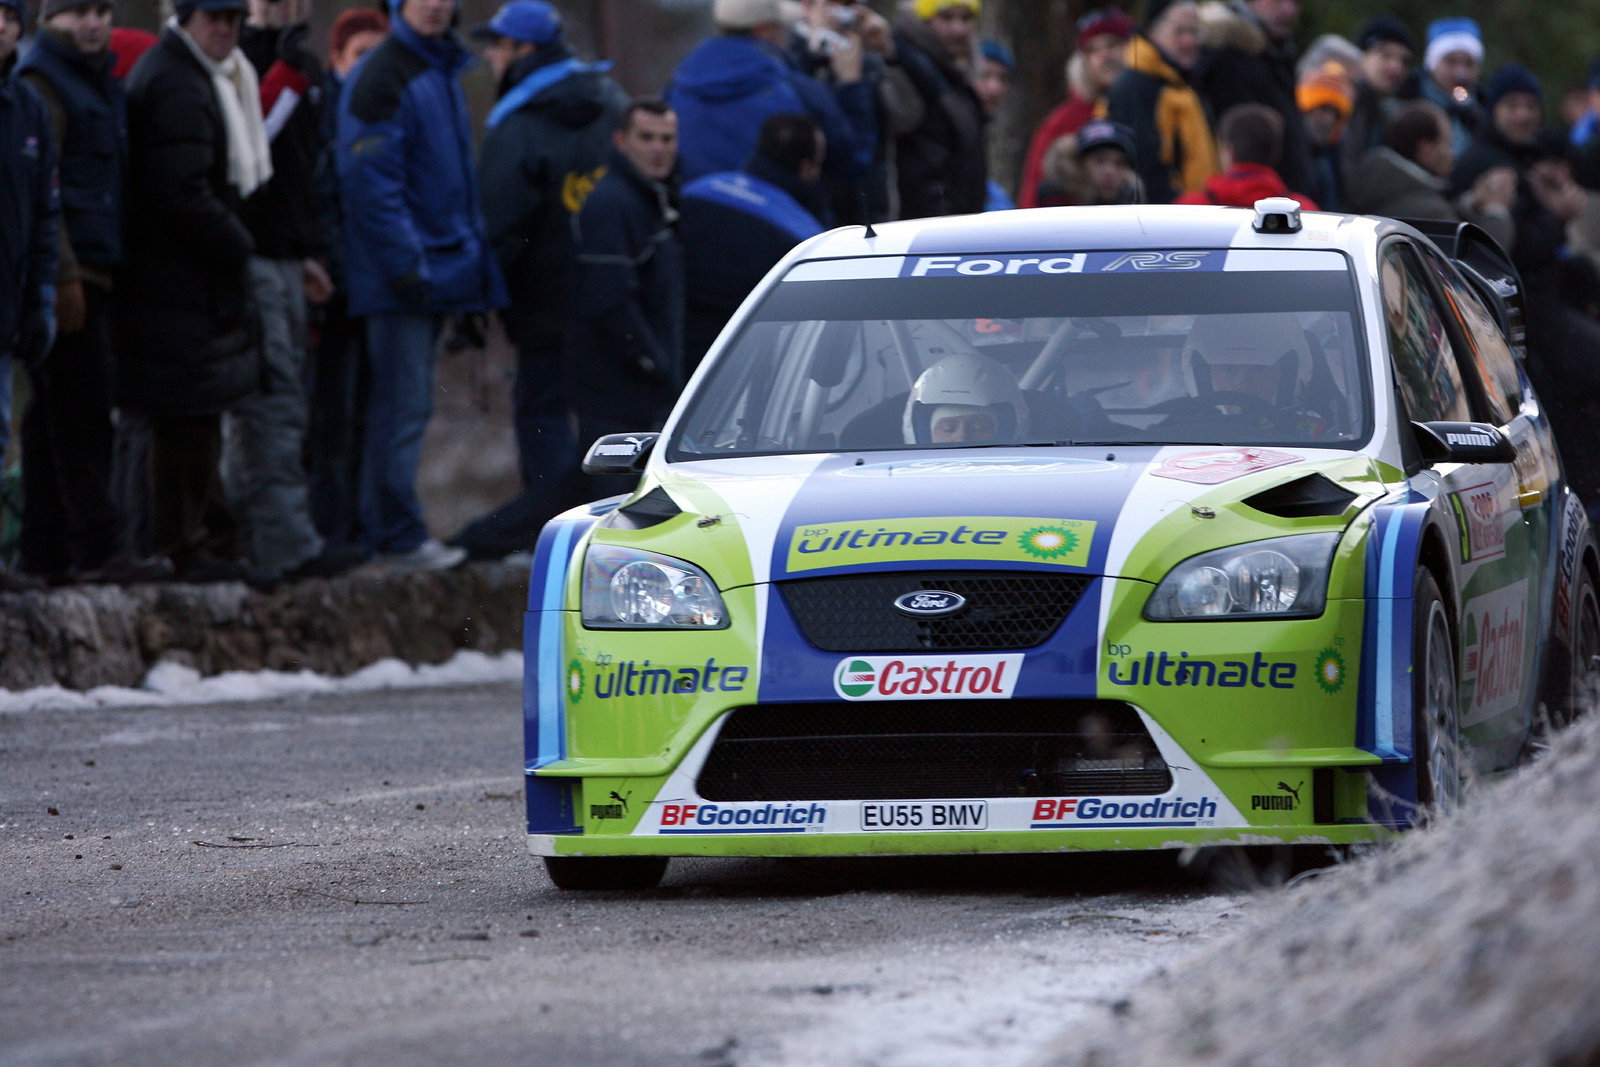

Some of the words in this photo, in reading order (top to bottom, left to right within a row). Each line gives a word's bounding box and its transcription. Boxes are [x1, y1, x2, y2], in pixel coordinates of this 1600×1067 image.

[911, 253, 1087, 276] Ford
[1101, 251, 1211, 272] RS
[1446, 433, 1492, 446] PUMA
[803, 527, 829, 539] bp
[1451, 493, 1469, 561] 3
[798, 526, 1008, 554] ultimate
[911, 594, 949, 608] Ford
[1107, 639, 1132, 659] bp
[1476, 600, 1525, 708] Castrol
[594, 658, 748, 698] ultimate
[877, 660, 1007, 696] Castrol
[1108, 651, 1297, 688] ultimate
[660, 803, 827, 826] BFGoodrich
[1032, 797, 1217, 820] BFGoodrich
[1251, 795, 1293, 811] PUMA
[864, 805, 923, 826] EU55
[932, 805, 984, 826] BMV
